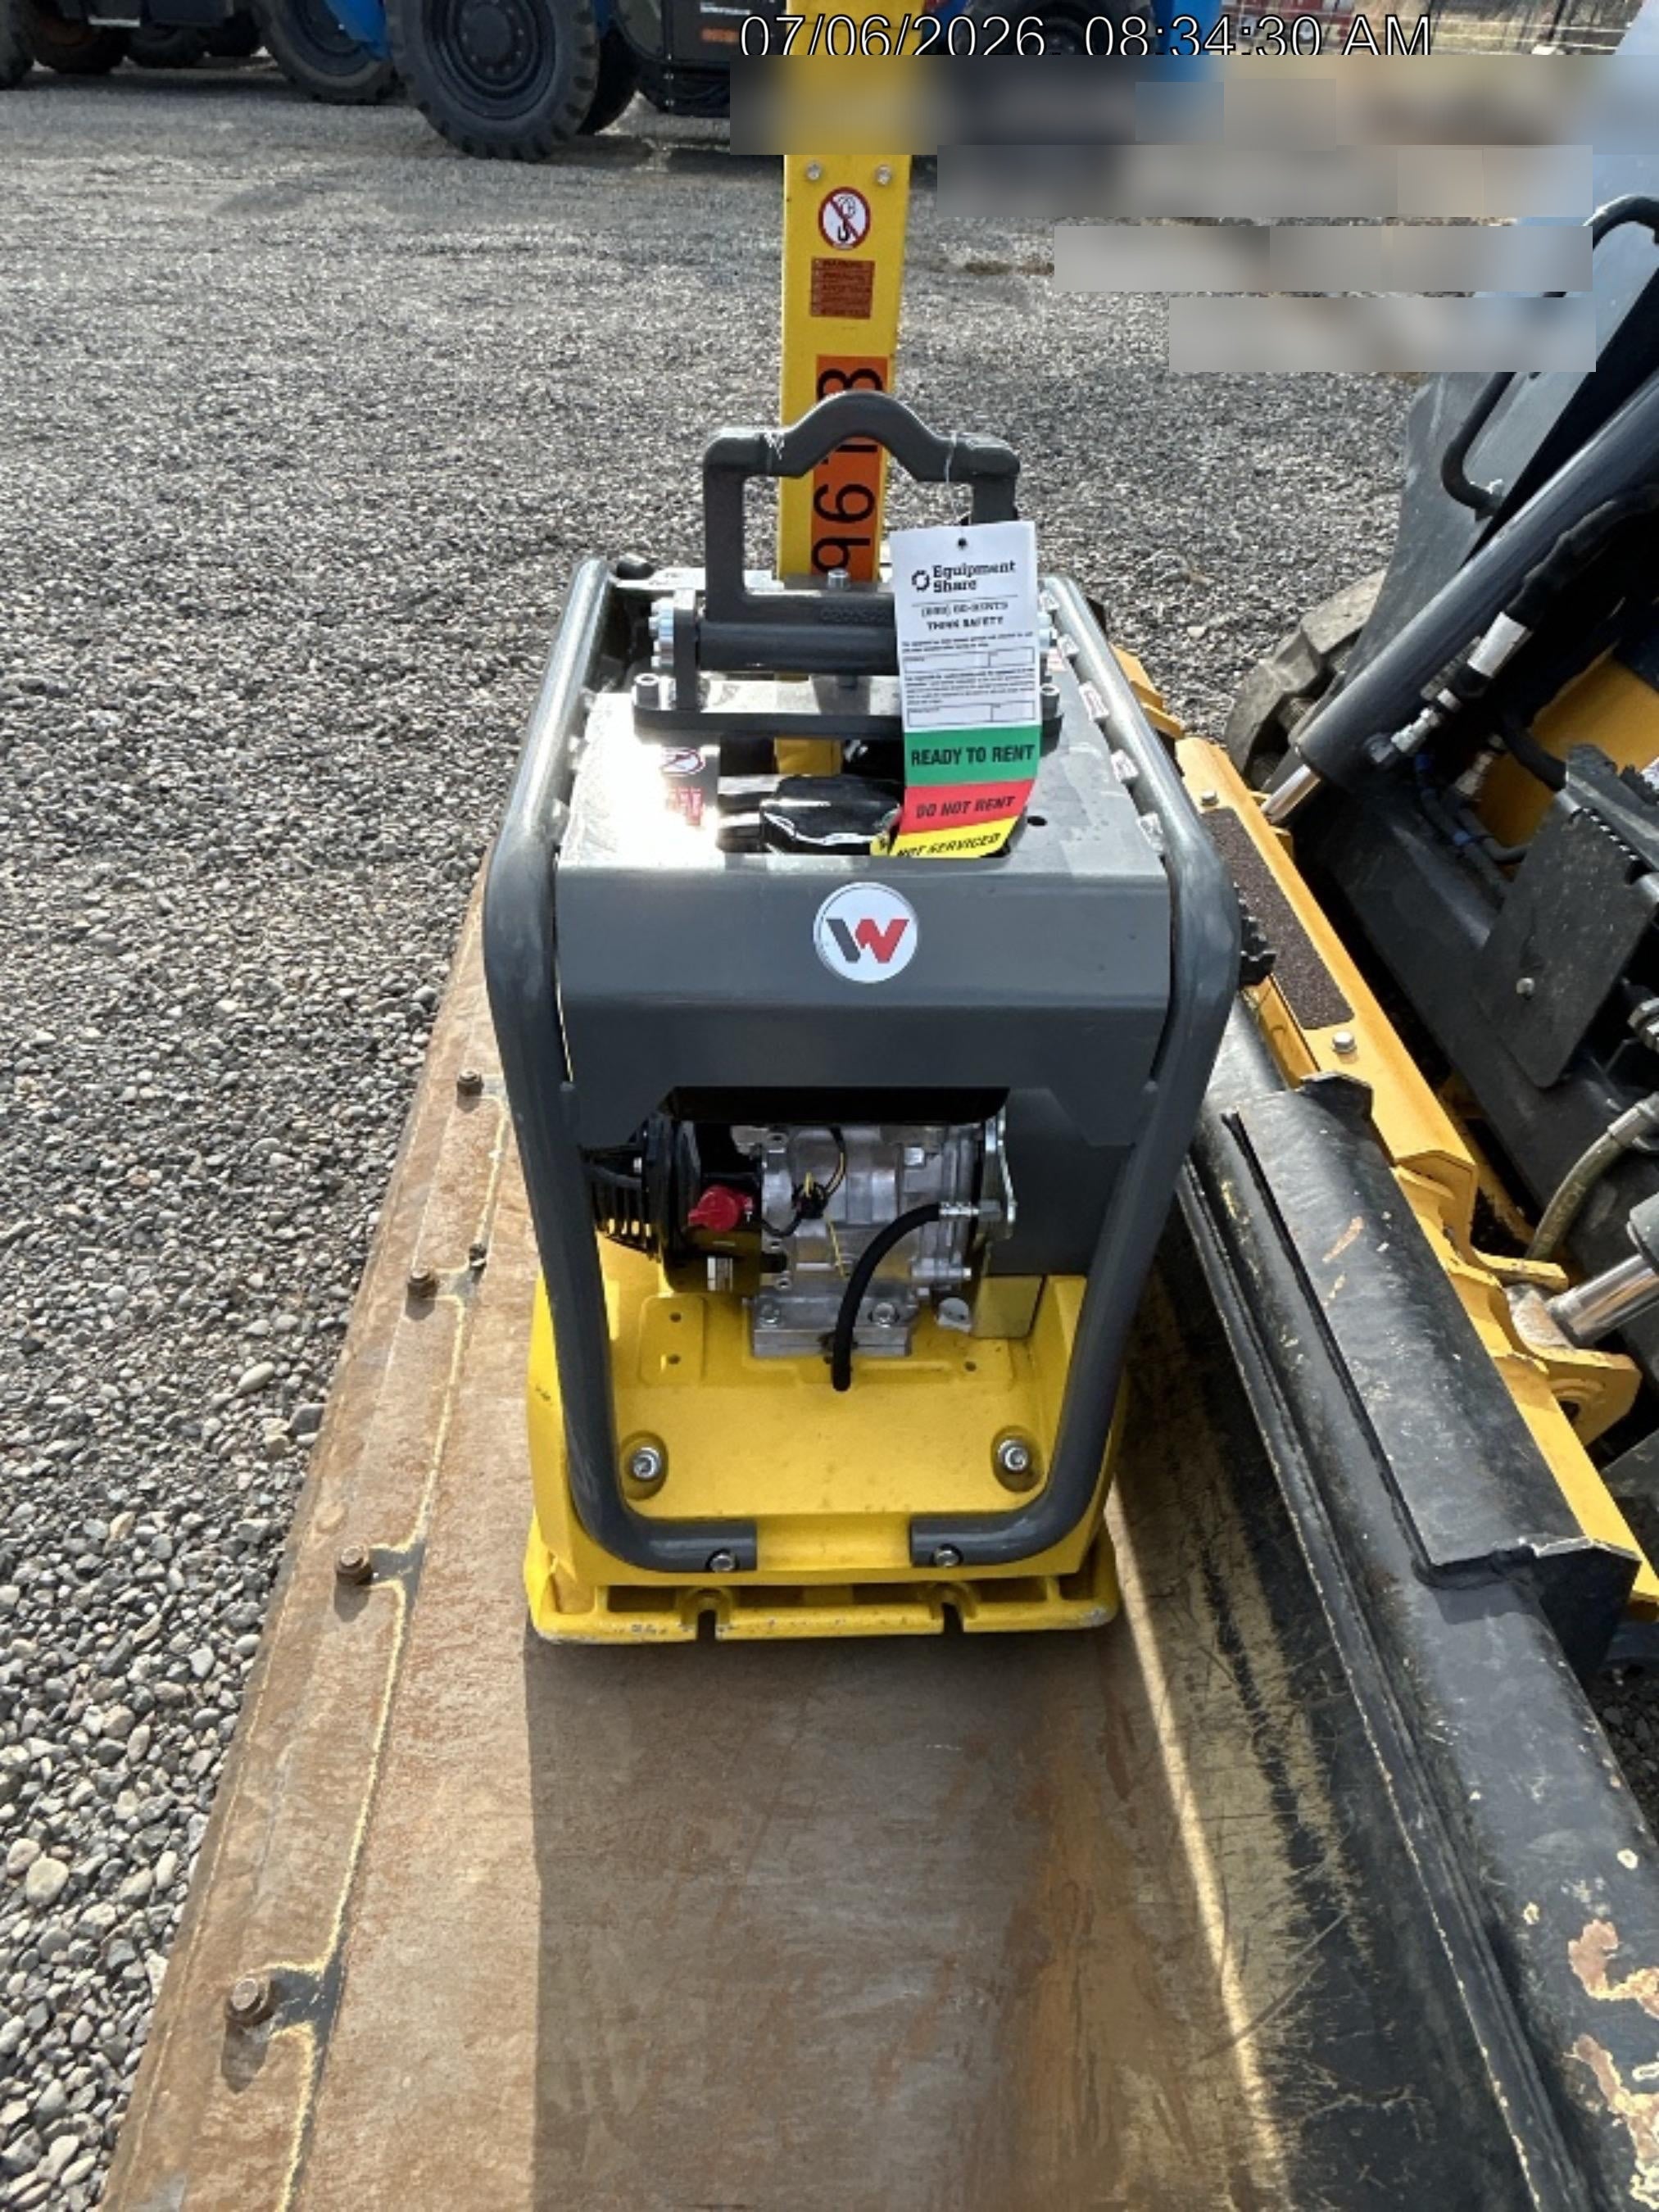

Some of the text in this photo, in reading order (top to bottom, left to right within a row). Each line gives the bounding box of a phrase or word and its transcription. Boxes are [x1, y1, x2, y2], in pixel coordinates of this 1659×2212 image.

[932, 560, 1016, 580] Equipment
[933, 579, 977, 593] Share
[911, 744, 1036, 766] READY TO RENT
[916, 796, 1016, 818] DO NOT RENT
[927, 832, 1001, 854] SERVICED
